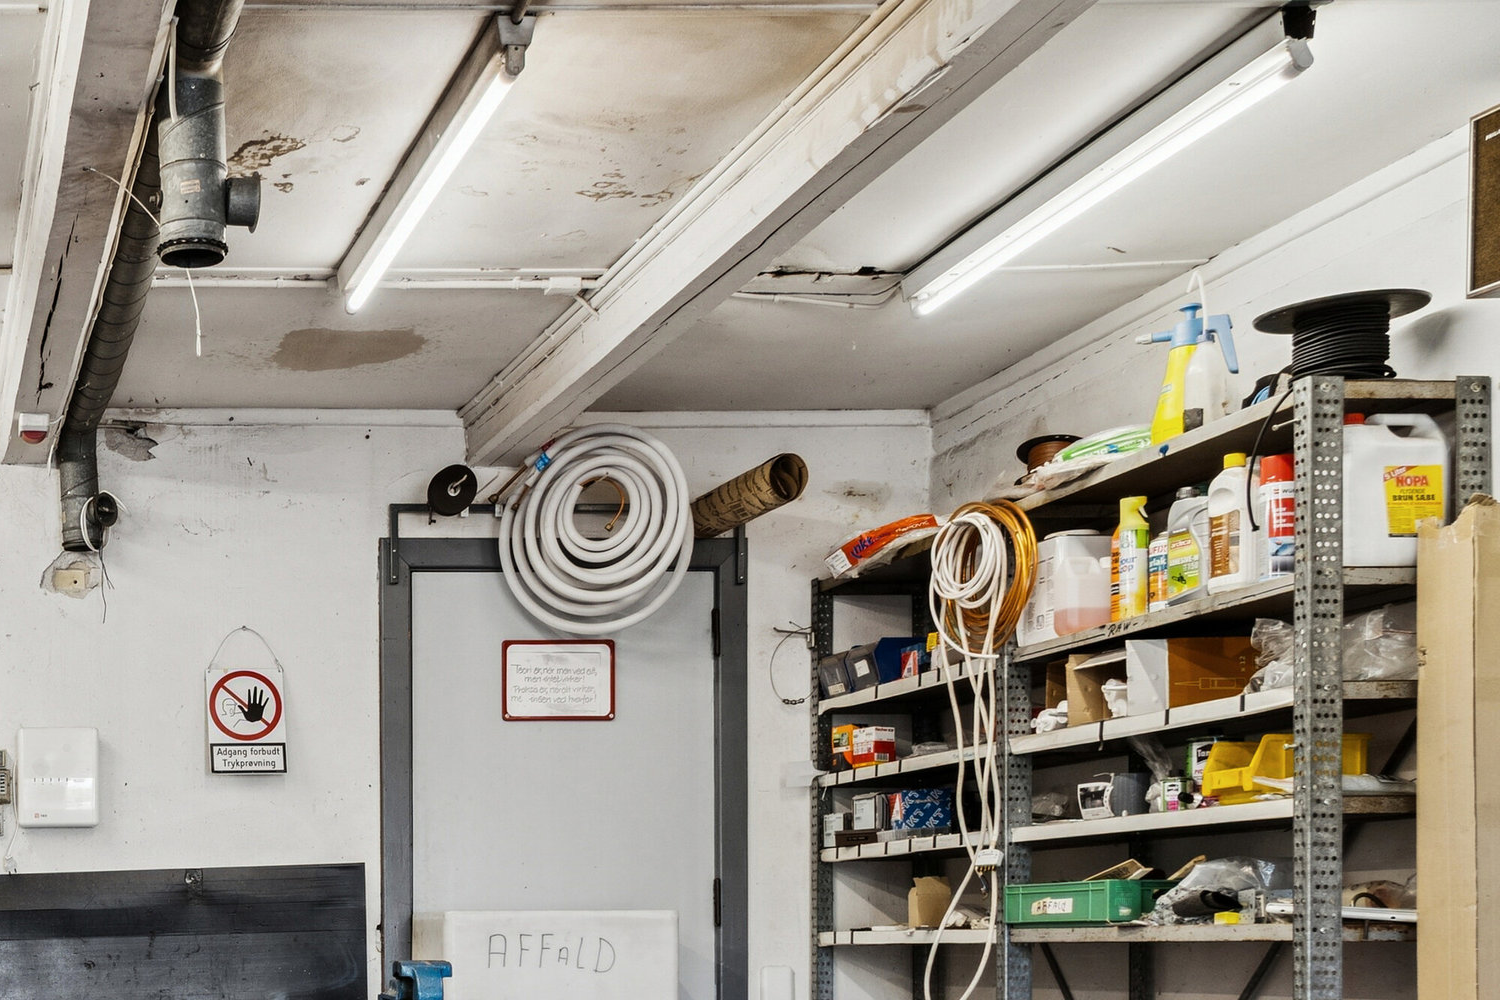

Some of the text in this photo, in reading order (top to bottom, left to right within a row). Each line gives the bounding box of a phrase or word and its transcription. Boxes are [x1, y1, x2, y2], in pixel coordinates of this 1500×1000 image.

[1396, 475, 1429, 487] NOPA
[217, 746, 280, 758] Adgang forbudt
[222, 758, 276, 770] Trykprøvning
[487, 932, 617, 974] AFFALD
